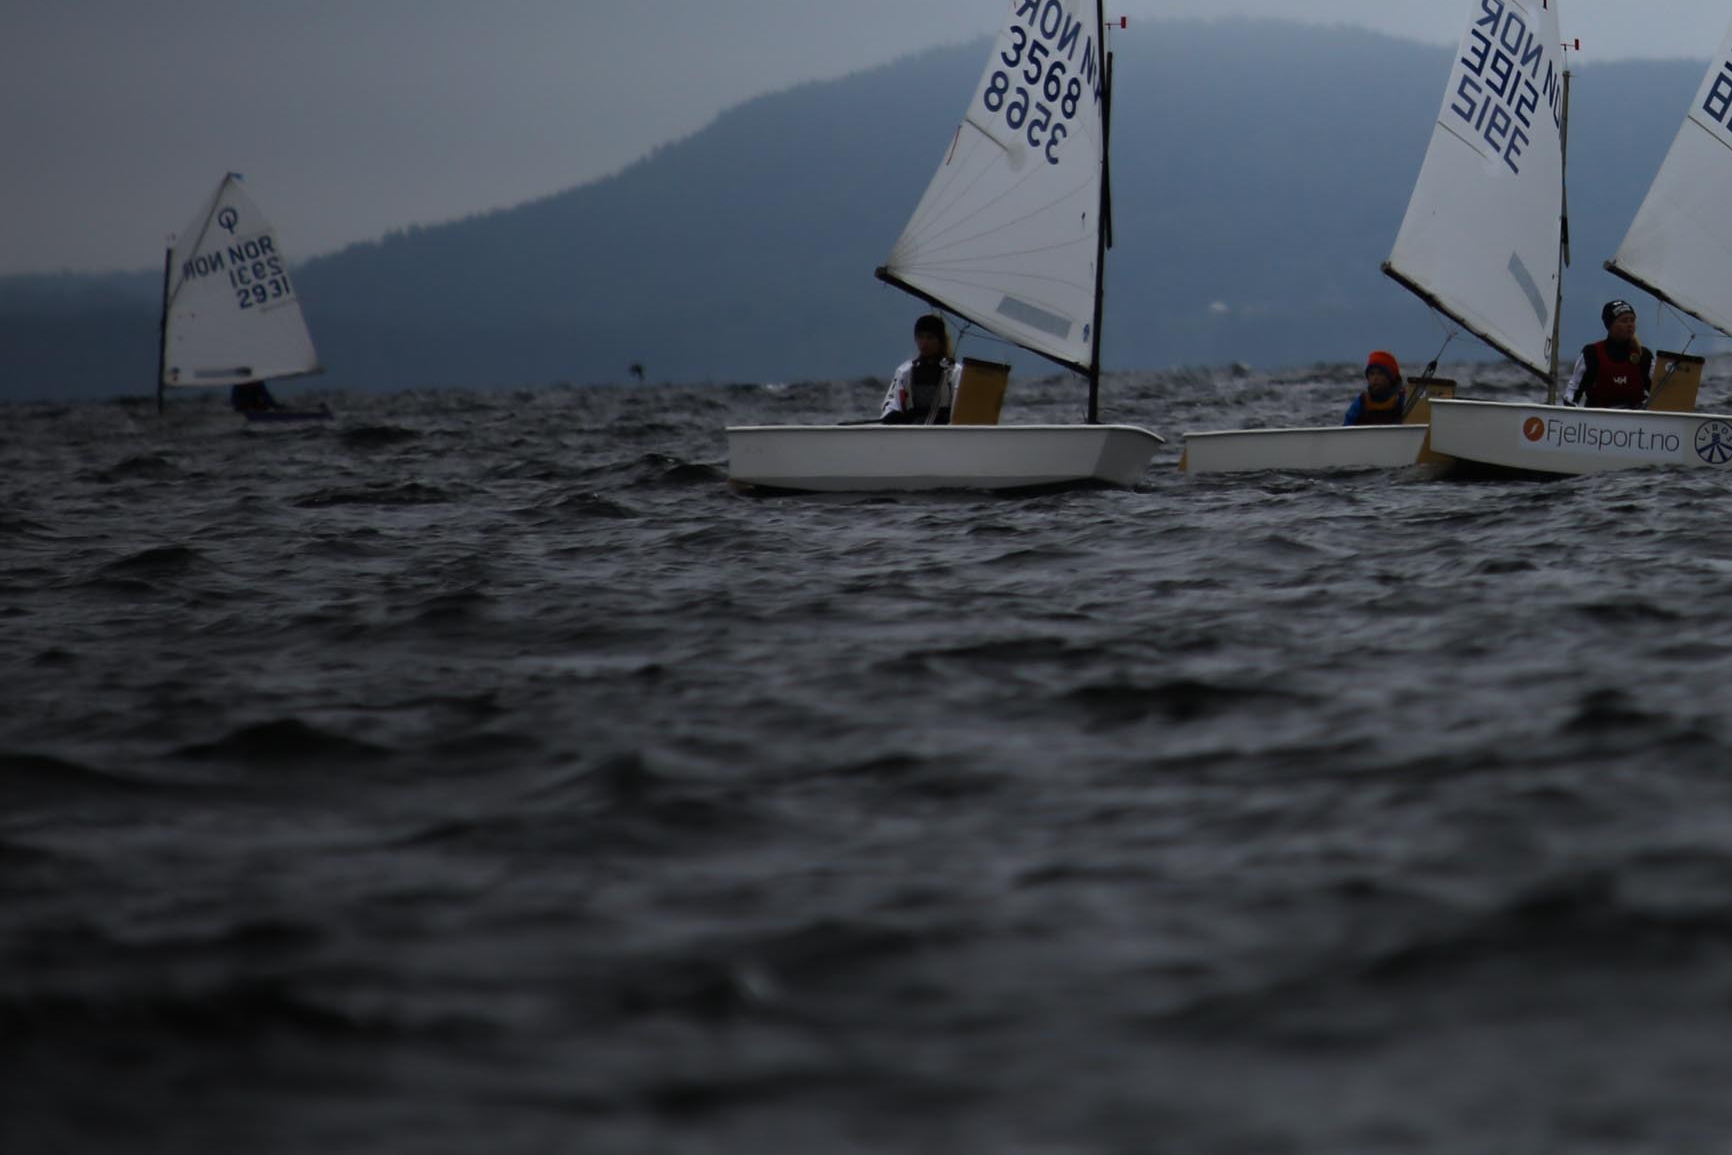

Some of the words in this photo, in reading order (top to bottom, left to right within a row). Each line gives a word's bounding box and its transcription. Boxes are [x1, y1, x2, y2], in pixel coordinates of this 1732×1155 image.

[1001, 25, 1081, 119] 3568
[1461, 28, 1539, 129] 3912
[1543, 59, 1561, 129] NO
[228, 235, 275, 265] NOR
[236, 275, 290, 310] 2931
[1546, 419, 1680, 452] Fjellsport.no
